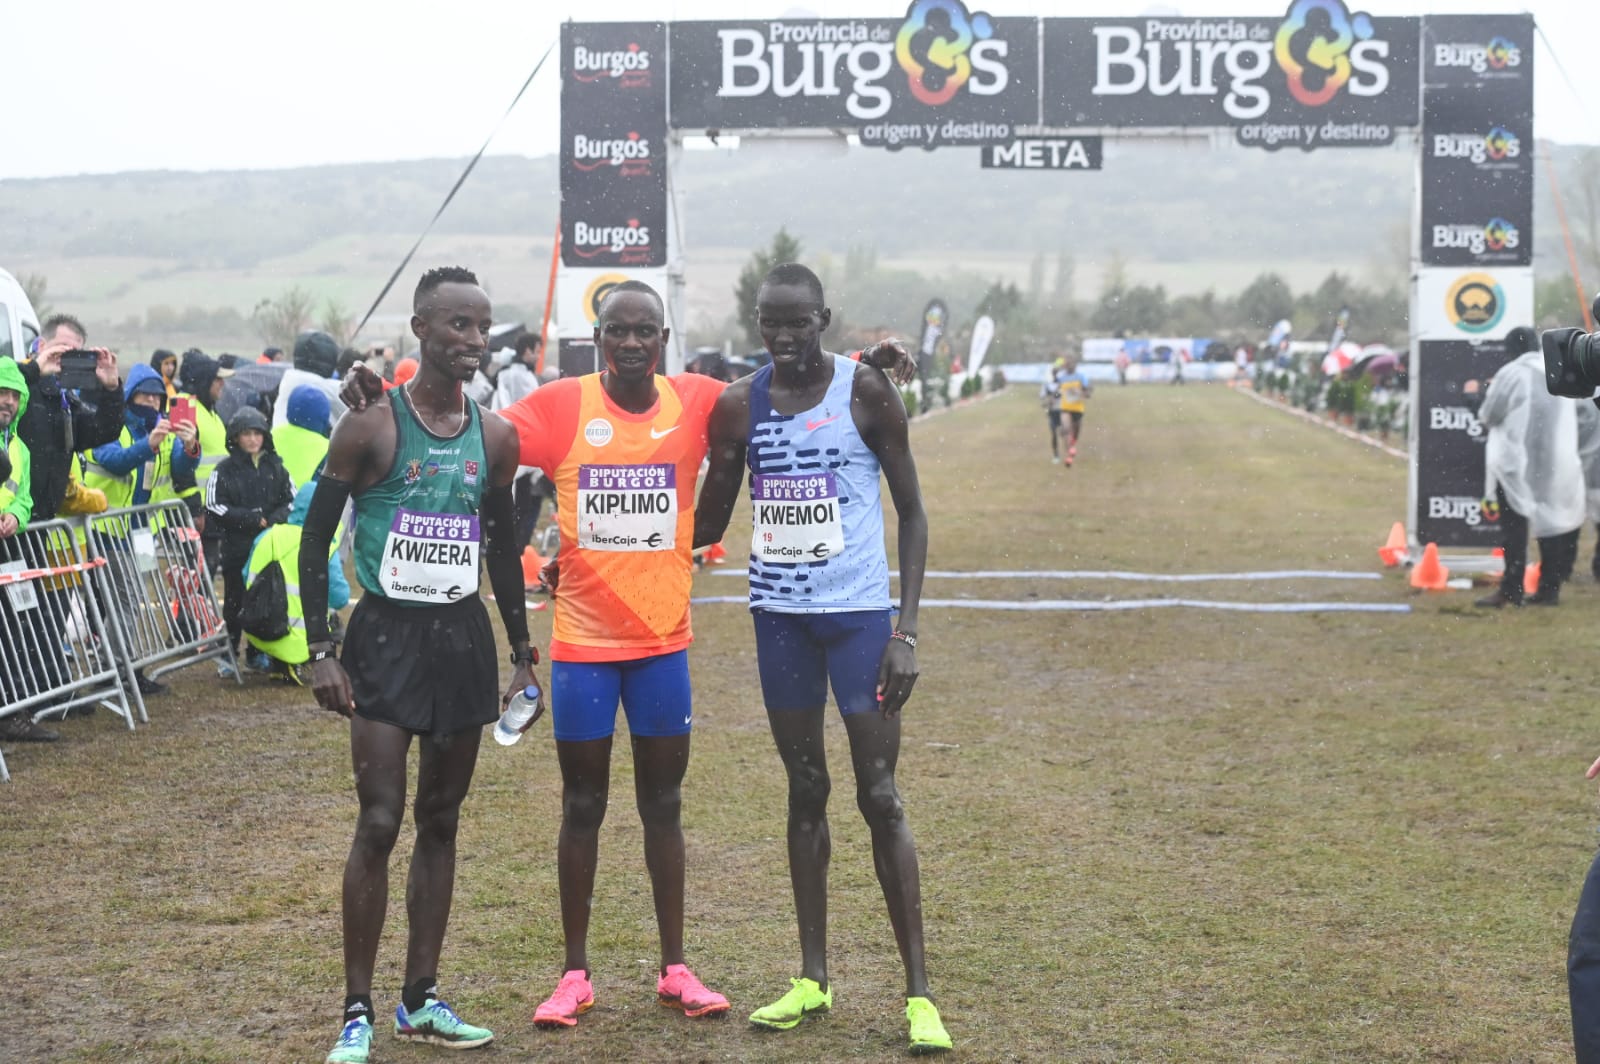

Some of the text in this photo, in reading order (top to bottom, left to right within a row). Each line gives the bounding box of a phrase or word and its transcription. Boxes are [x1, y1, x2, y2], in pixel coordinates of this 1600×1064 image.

[770, 22, 890, 43] Provincia de
[1146, 20, 1270, 41] Provincia de
[574, 45, 649, 77] Burgos
[716, 0, 1008, 119] Burgos
[1092, 0, 1389, 119] Burgos
[864, 119, 1009, 144] origen y destino
[1241, 119, 1389, 144] origen y destino
[574, 133, 649, 166] Burgos
[992, 140, 1090, 168] META
[574, 220, 649, 253] Burgos
[1430, 407, 1483, 436] Burg
[589, 467, 666, 478] DIPUTACIÓN
[589, 477, 667, 488] BURGOS
[763, 477, 827, 488] DIPUTACIÓN
[585, 493, 670, 514] KIPLIMO
[763, 487, 828, 499] BURGOS
[401, 513, 471, 529] DIPUTACIÓN
[760, 503, 834, 525] KWEMOI
[399, 522, 471, 539] BURGOS
[588, 521, 594, 531] 1
[763, 532, 773, 542] 19
[390, 537, 472, 567] KWIZERA
[391, 566, 398, 577] 3
